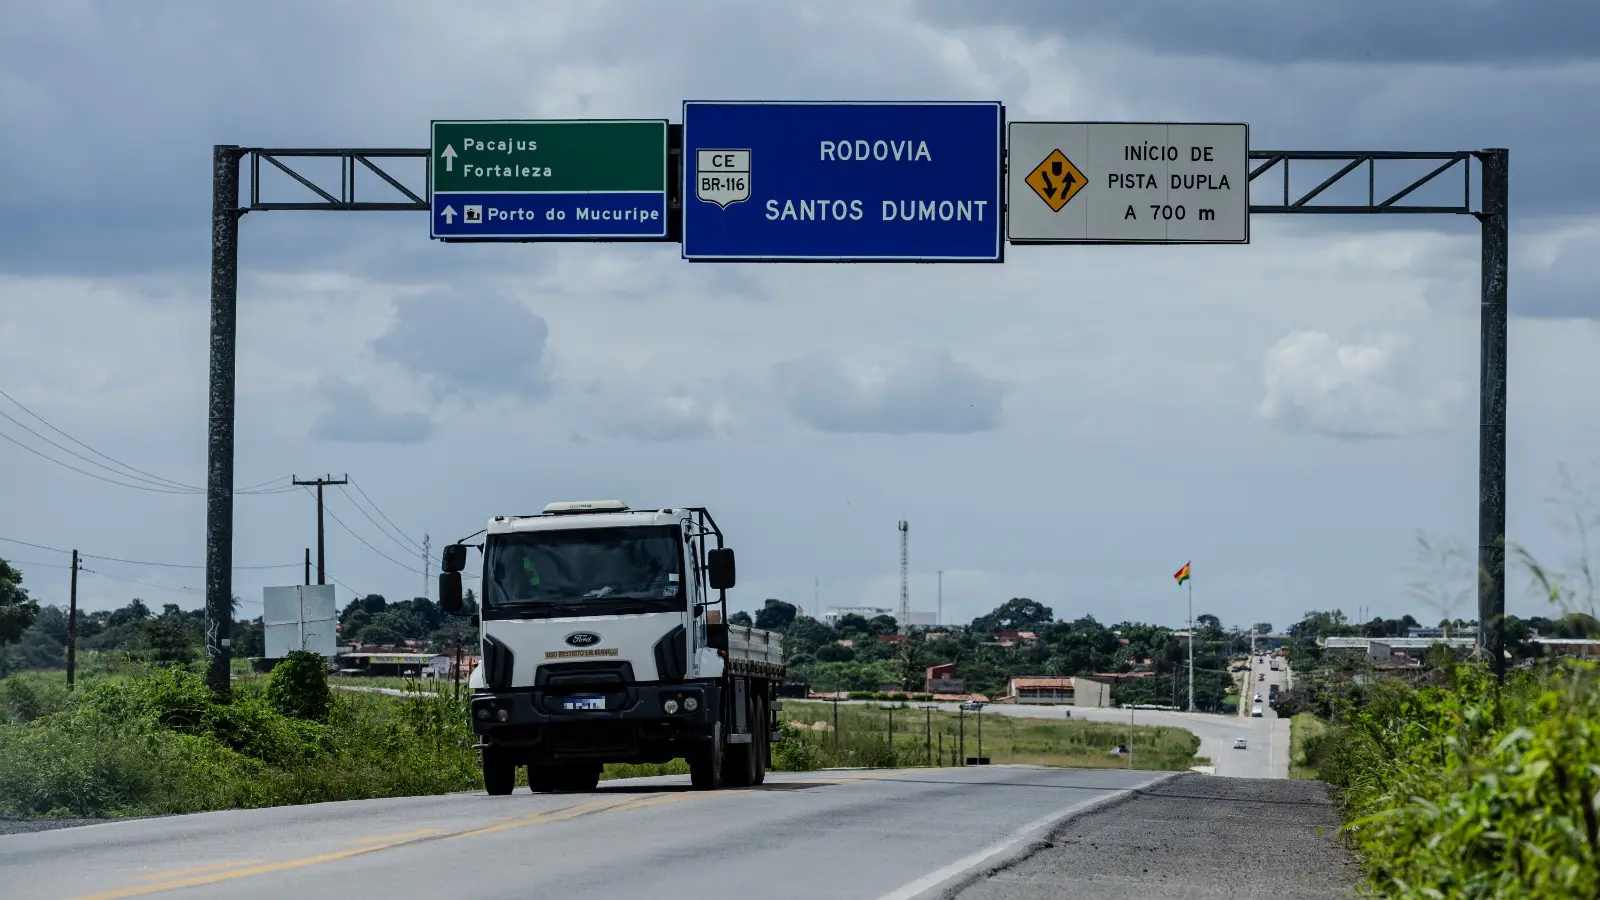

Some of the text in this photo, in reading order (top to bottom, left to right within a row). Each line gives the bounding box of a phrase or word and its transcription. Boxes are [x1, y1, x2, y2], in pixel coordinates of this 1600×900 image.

[464, 138, 538, 154] Pacajus
[820, 140, 932, 161] RODOVIA
[1125, 140, 1214, 161] INÍCIO DE
[712, 154, 735, 167] CE
[464, 164, 552, 177] Fortaleza
[702, 178, 745, 191] BR-116
[1108, 174, 1230, 189] PISTA DUPLA
[488, 207, 659, 223] Porto do Mucuripe
[765, 199, 987, 221] SANTOS DUMONT
[1124, 205, 1215, 220] A 700 m
[573, 634, 592, 643] Ford
